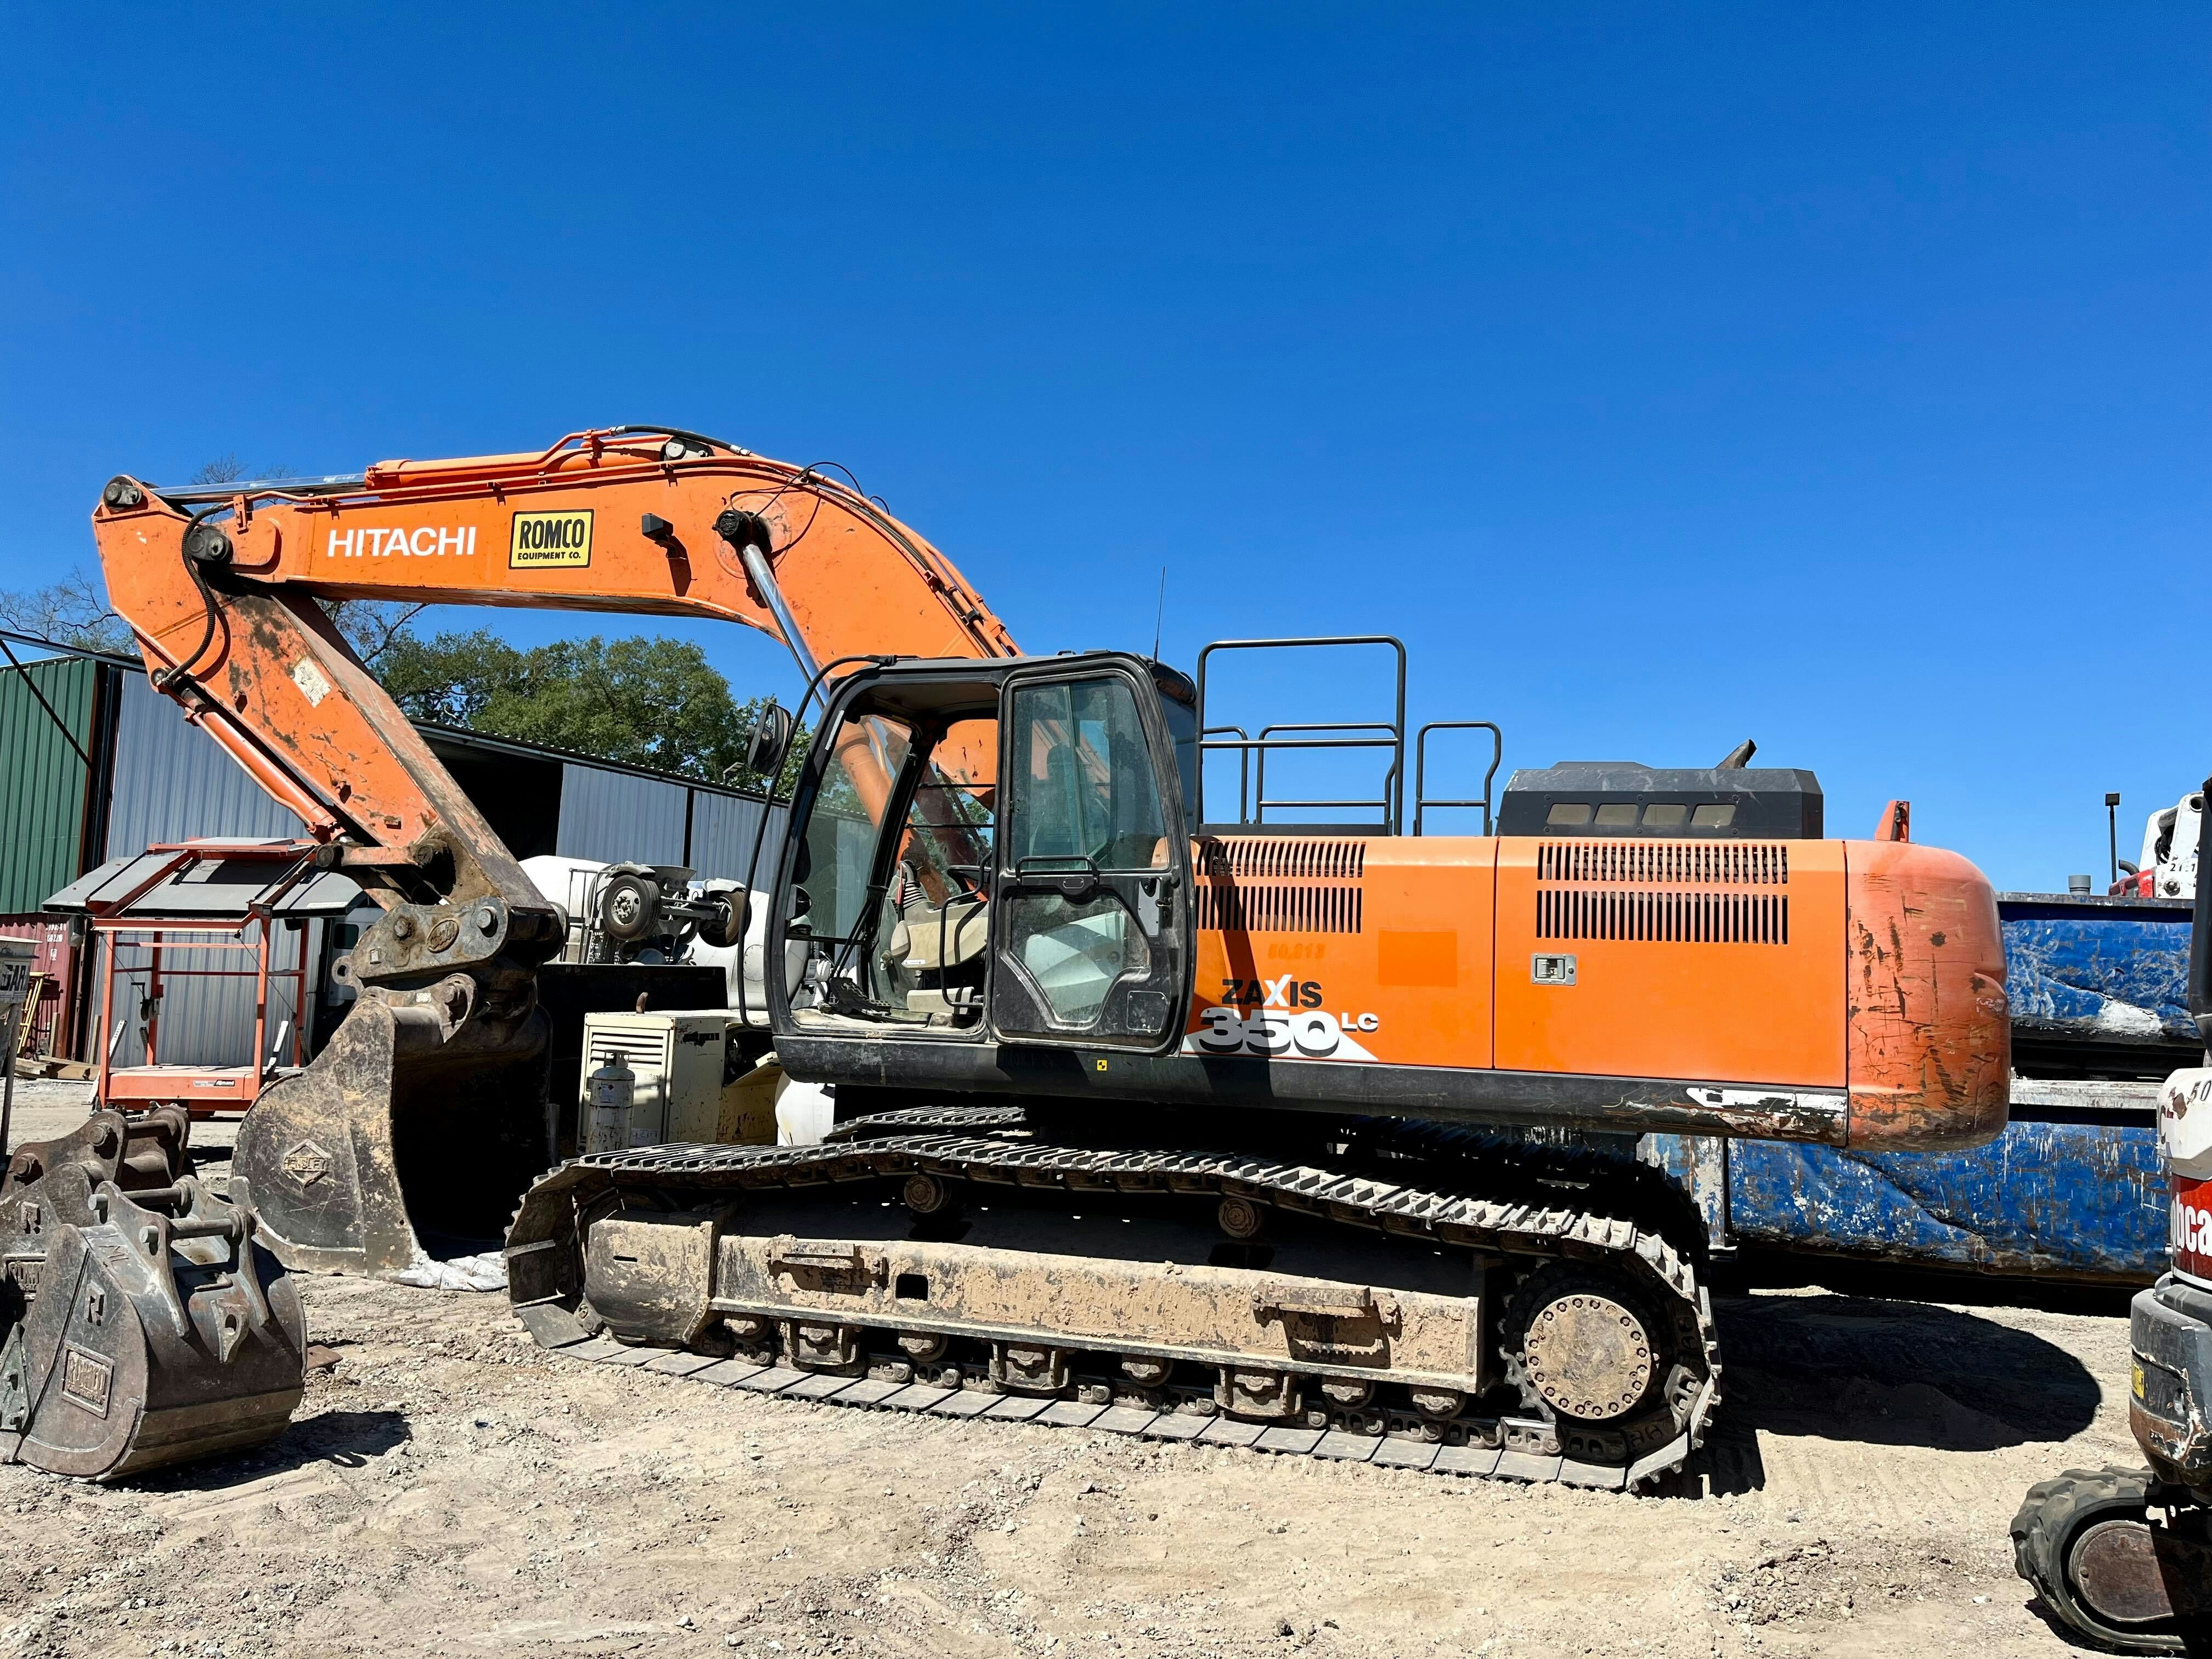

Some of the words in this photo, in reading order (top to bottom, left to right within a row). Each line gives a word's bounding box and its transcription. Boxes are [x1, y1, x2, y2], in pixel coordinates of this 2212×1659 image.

[328, 527, 476, 557] HITACHI
[519, 518, 585, 549] ROMCO
[517, 551, 566, 560] EQUIPMENT
[569, 551, 582, 560] CO.
[1222, 974, 1322, 1008] ZAXIS
[1199, 1007, 1340, 1058] 350
[1341, 1012, 1379, 1032] LC
[20, 1201, 41, 1234] R
[84, 1280, 106, 1327] R
